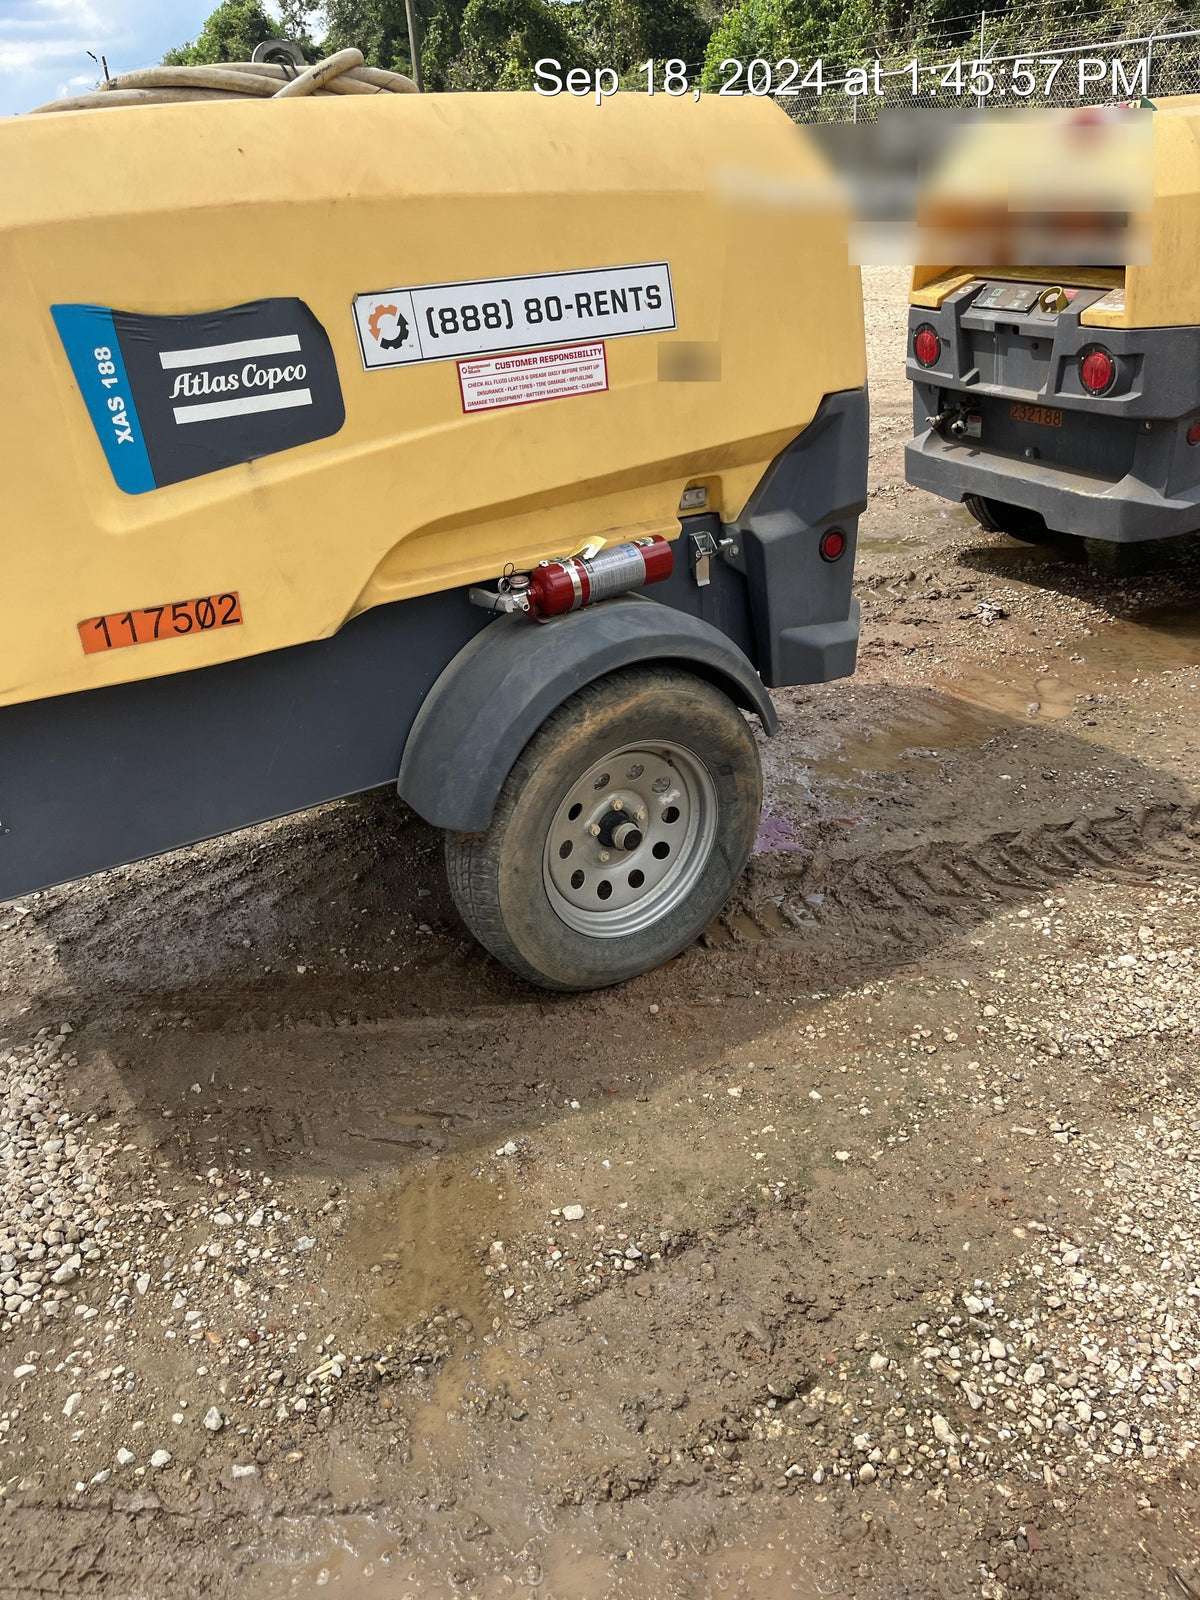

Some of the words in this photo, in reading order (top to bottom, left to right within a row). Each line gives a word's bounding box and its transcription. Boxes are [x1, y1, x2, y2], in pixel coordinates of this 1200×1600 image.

[425, 299, 514, 338] (888)
[524, 284, 662, 325] 80-RENTS
[94, 346, 119, 389] 188
[495, 357, 538, 370] CUSTOMER
[539, 348, 602, 364] RESPONSIBILITY
[169, 371, 239, 399] Atlas
[241, 363, 306, 390] Copco
[476, 388, 504, 396] INSURANCE
[569, 374, 594, 382] REFUELING
[495, 394, 523, 402] EQUIPMENT
[546, 384, 578, 394] MAINTENANCE
[108, 396, 134, 444] XAS
[1010, 404, 1061, 425] 232188
[94, 594, 240, 647] 117502
